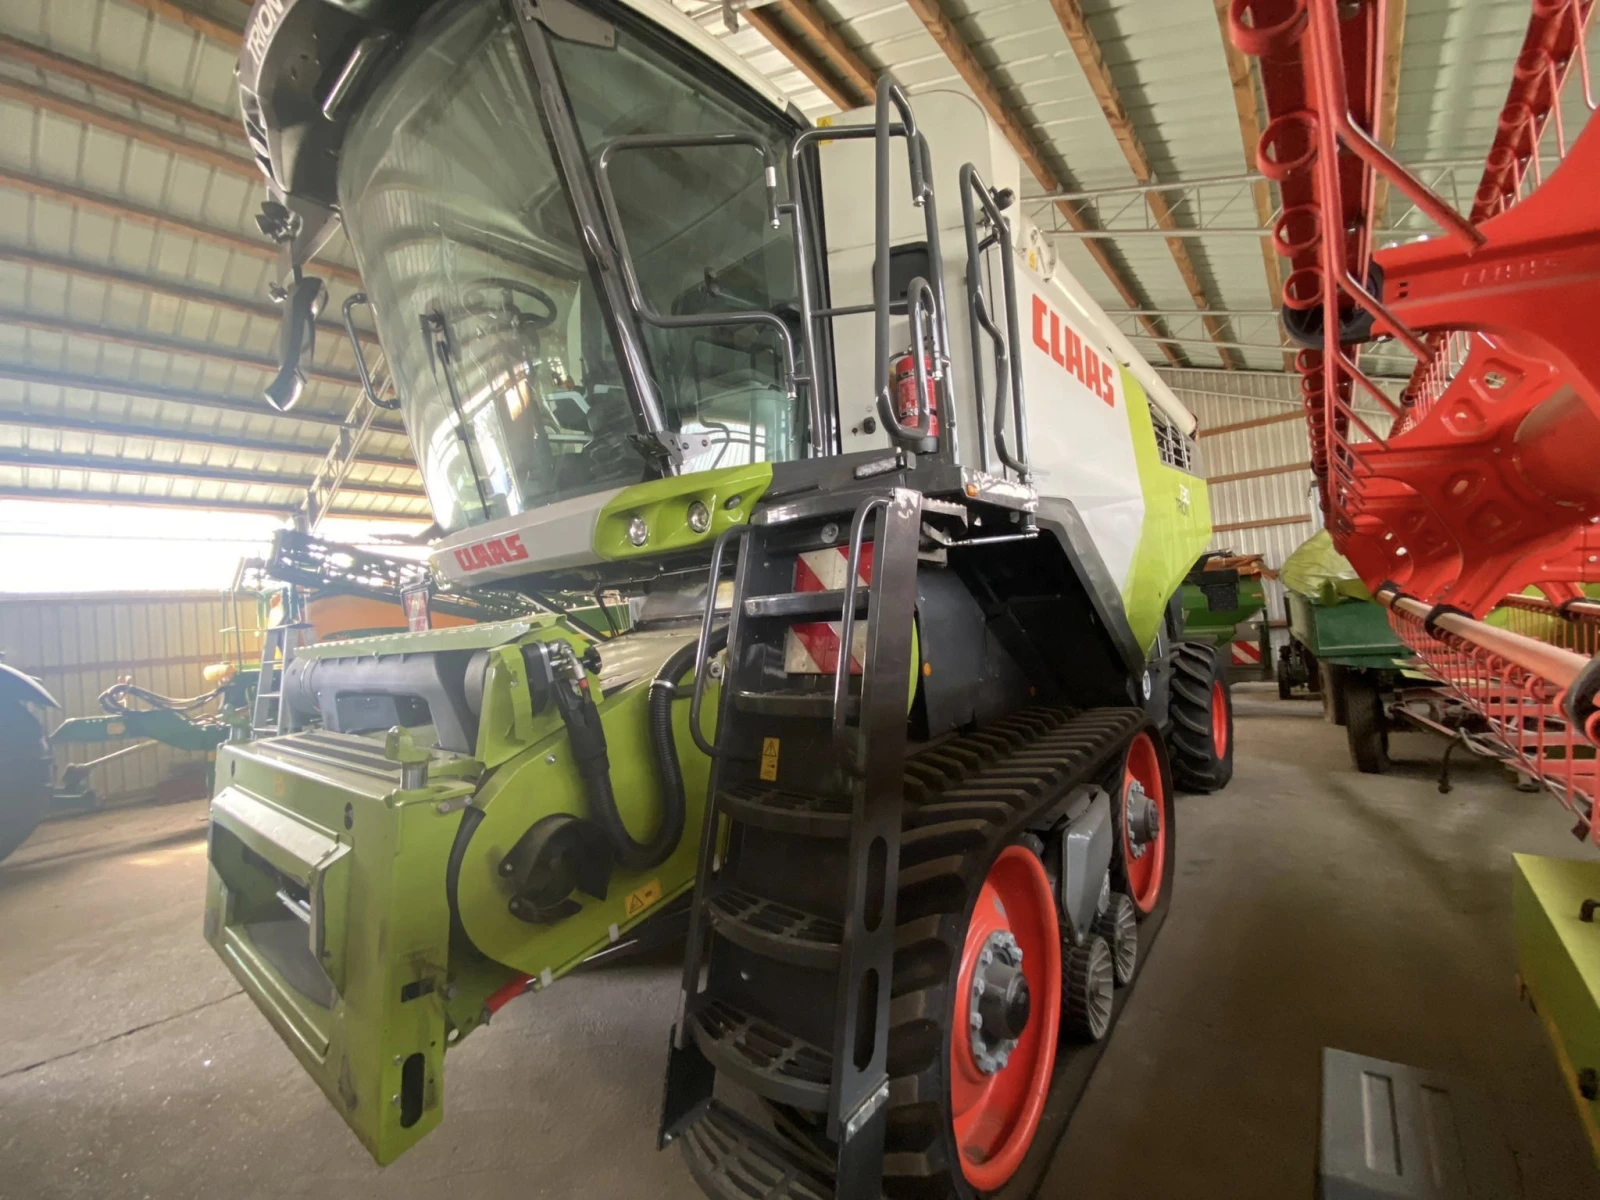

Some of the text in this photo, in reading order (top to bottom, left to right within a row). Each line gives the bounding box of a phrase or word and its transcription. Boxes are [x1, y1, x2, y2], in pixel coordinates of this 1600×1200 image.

[246, 0, 284, 65] TRION
[1032, 293, 1115, 409] CLAAS
[453, 533, 530, 573] CLAAS
